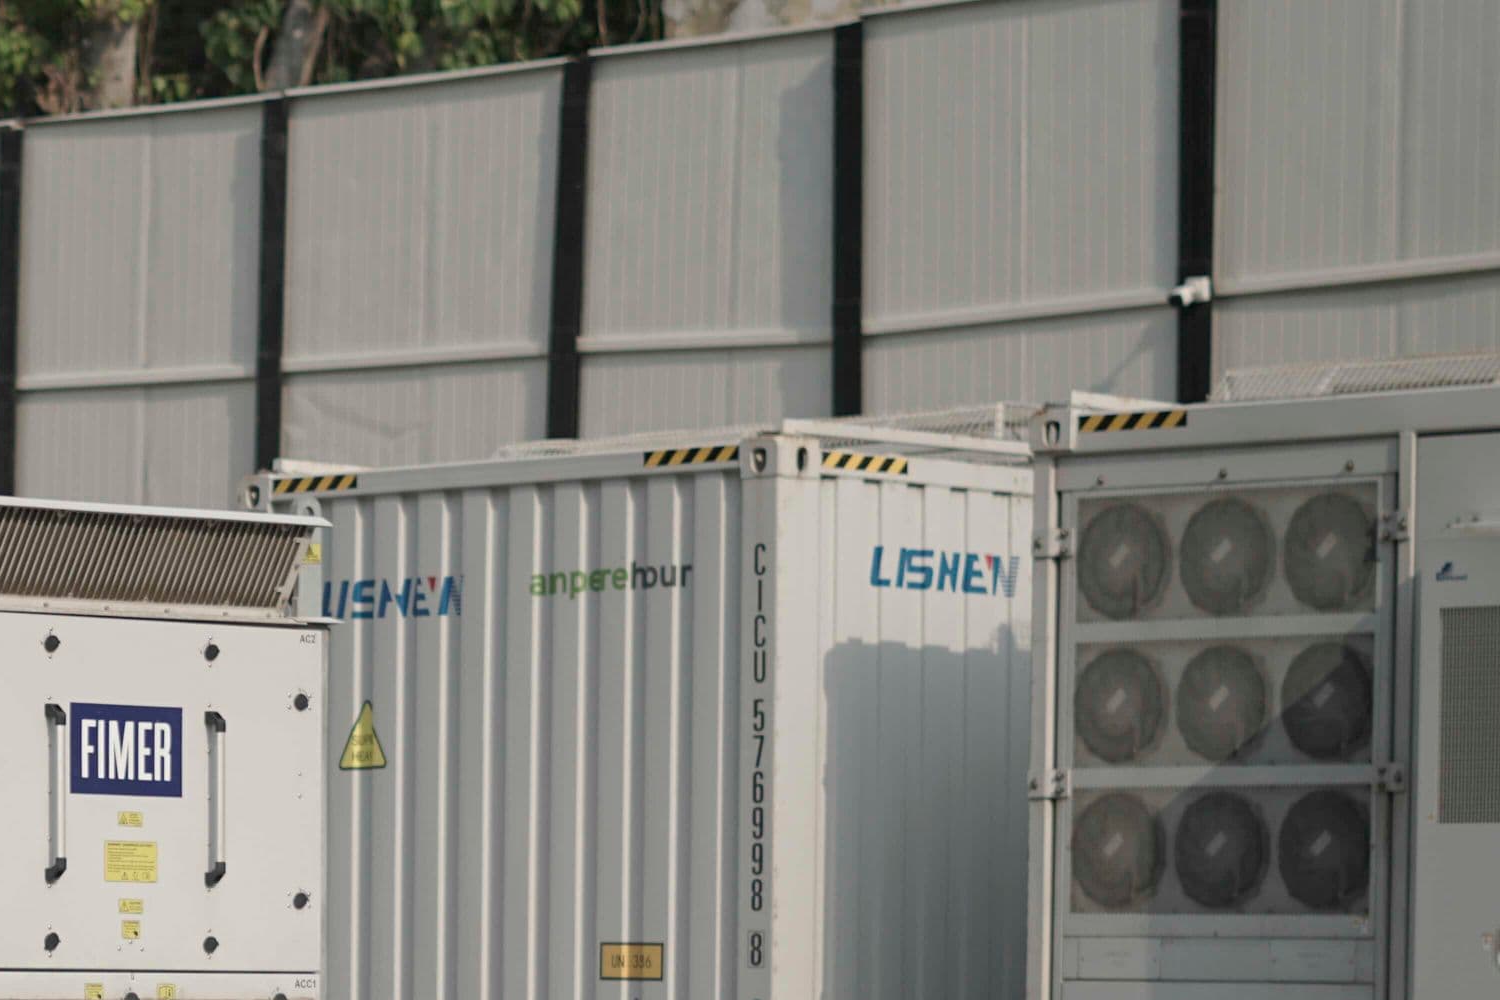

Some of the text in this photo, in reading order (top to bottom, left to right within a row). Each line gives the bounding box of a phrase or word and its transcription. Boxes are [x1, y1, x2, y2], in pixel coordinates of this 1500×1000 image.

[754, 543, 766, 683] CICU
[300, 634, 316, 644] AC2
[81, 718, 172, 782] FIMER
[751, 699, 765, 911] 576998
[611, 955, 625, 969] UN
[751, 933, 762, 967] 8
[294, 979, 317, 989] ACC1
